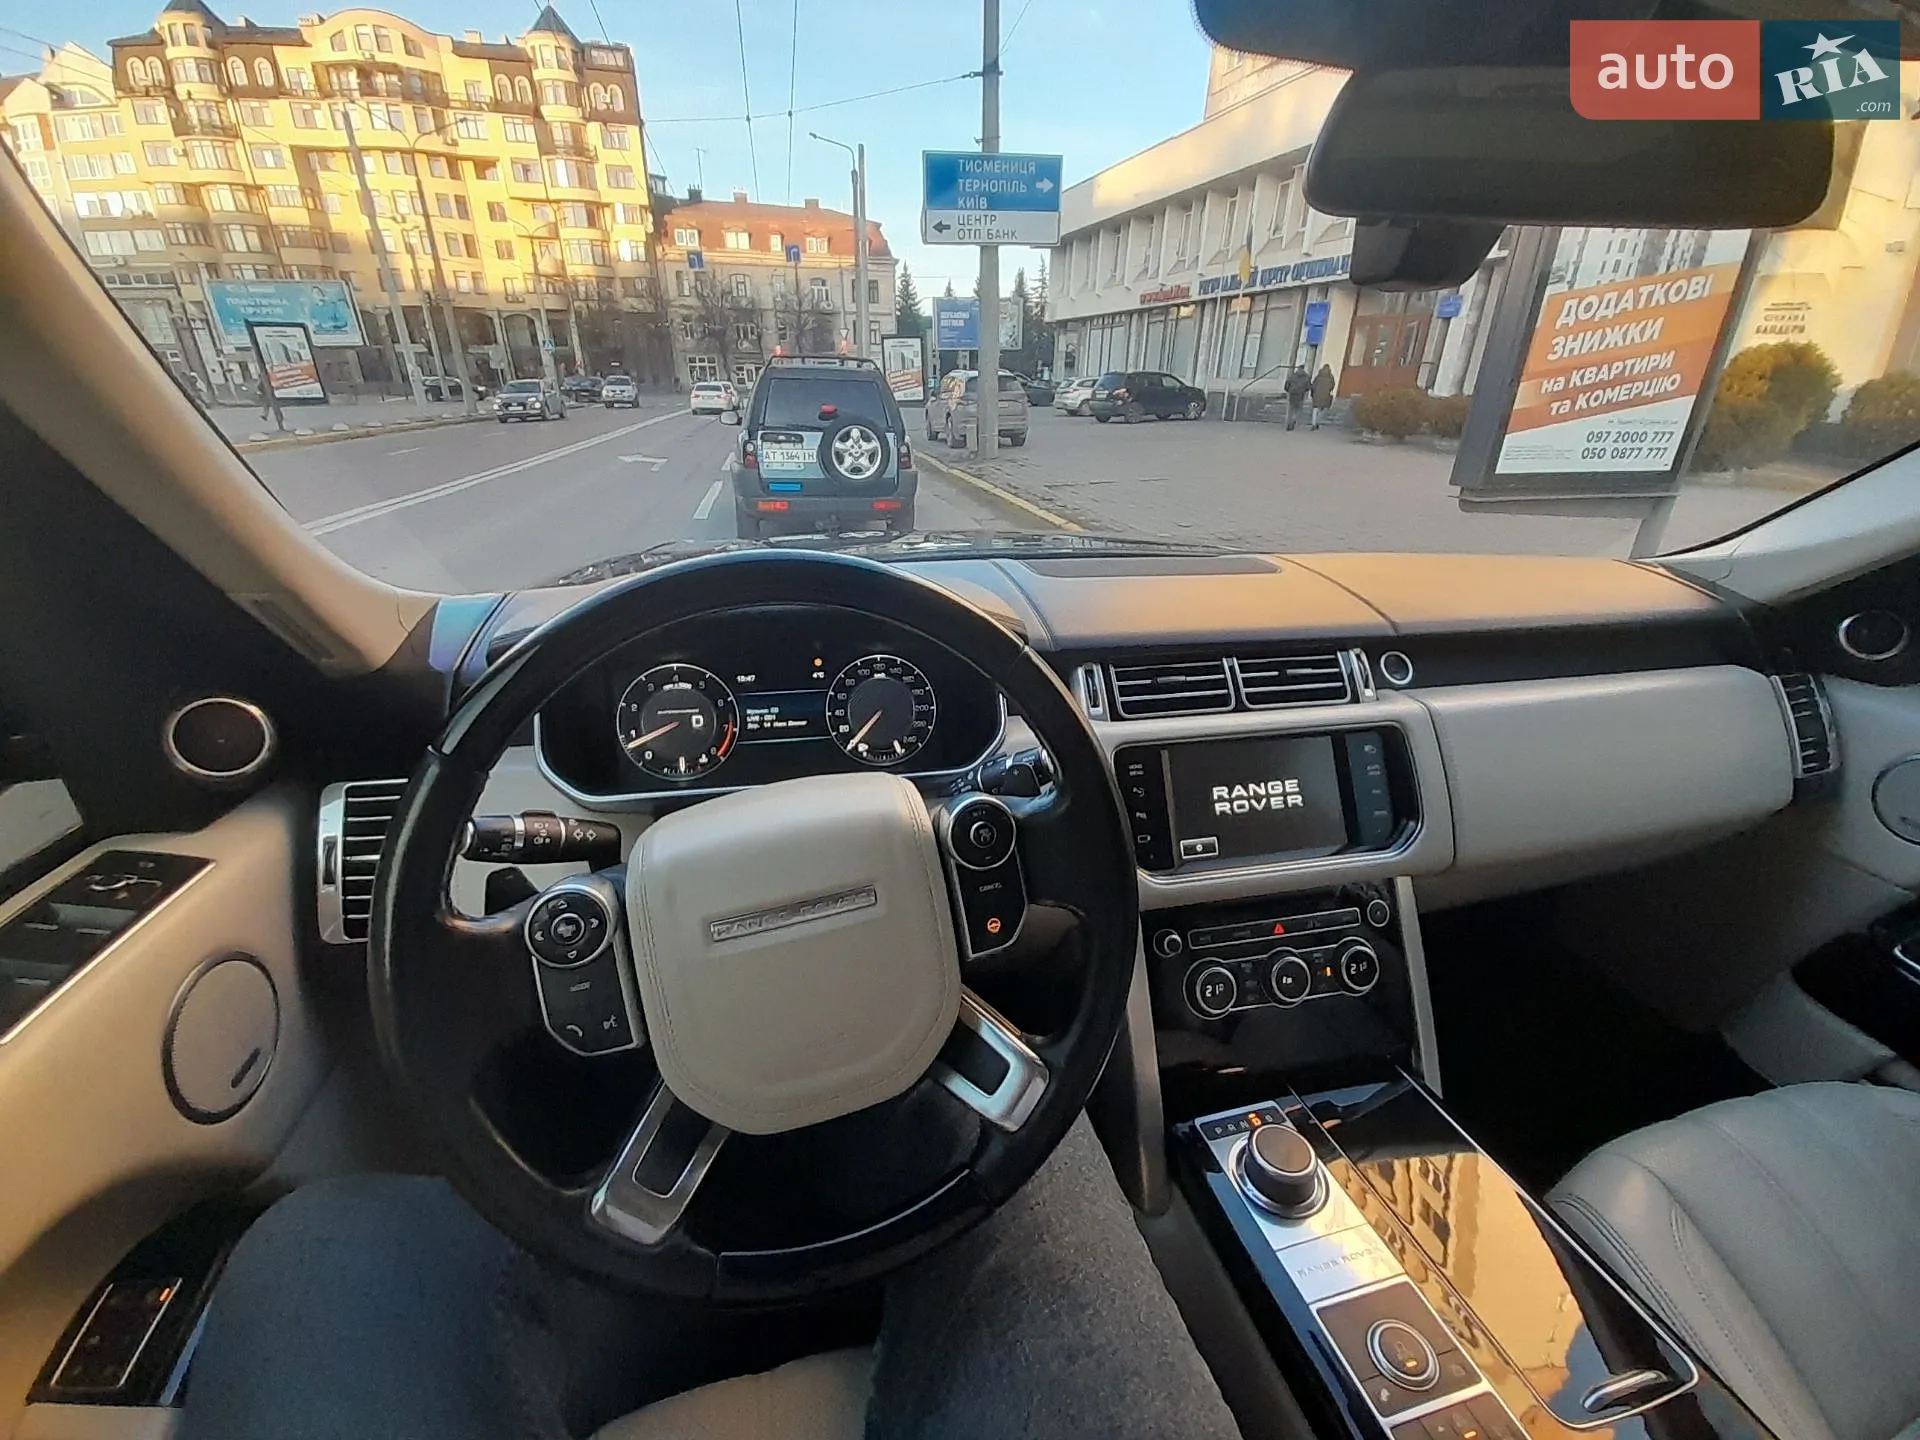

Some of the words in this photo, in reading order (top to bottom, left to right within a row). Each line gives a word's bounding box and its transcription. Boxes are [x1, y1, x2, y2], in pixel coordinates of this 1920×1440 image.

[957, 159, 1036, 175] ТИСМЕНИЦЯ
[957, 179, 1028, 193] ТЕРНОПІЛЬ
[957, 196, 988, 209] КИЇВ
[957, 214, 997, 226] ЦЕНТР
[957, 228, 982, 240] ОТП
[986, 229, 1018, 240] БАНК
[1554, 274, 1714, 330] ДОДАТКОВІ
[1547, 317, 1664, 361] ЗНИЖКИ
[1540, 376, 1564, 394] на
[1568, 350, 1676, 388] КВАРТИРИ
[1549, 399, 1571, 415] та
[1574, 373, 1682, 411] КОМЕРЦІЮ
[1586, 431, 1609, 443] 097
[1612, 431, 1648, 443] 2000
[1650, 431, 1675, 443] 777
[1581, 448, 1606, 460] 050
[1611, 448, 1642, 460] 0877
[1645, 448, 1668, 459] 777
[631, 703, 638, 712] 2
[645, 751, 653, 760] 0
[1212, 779, 1300, 800] RANGE
[1215, 794, 1303, 815] ROVER
